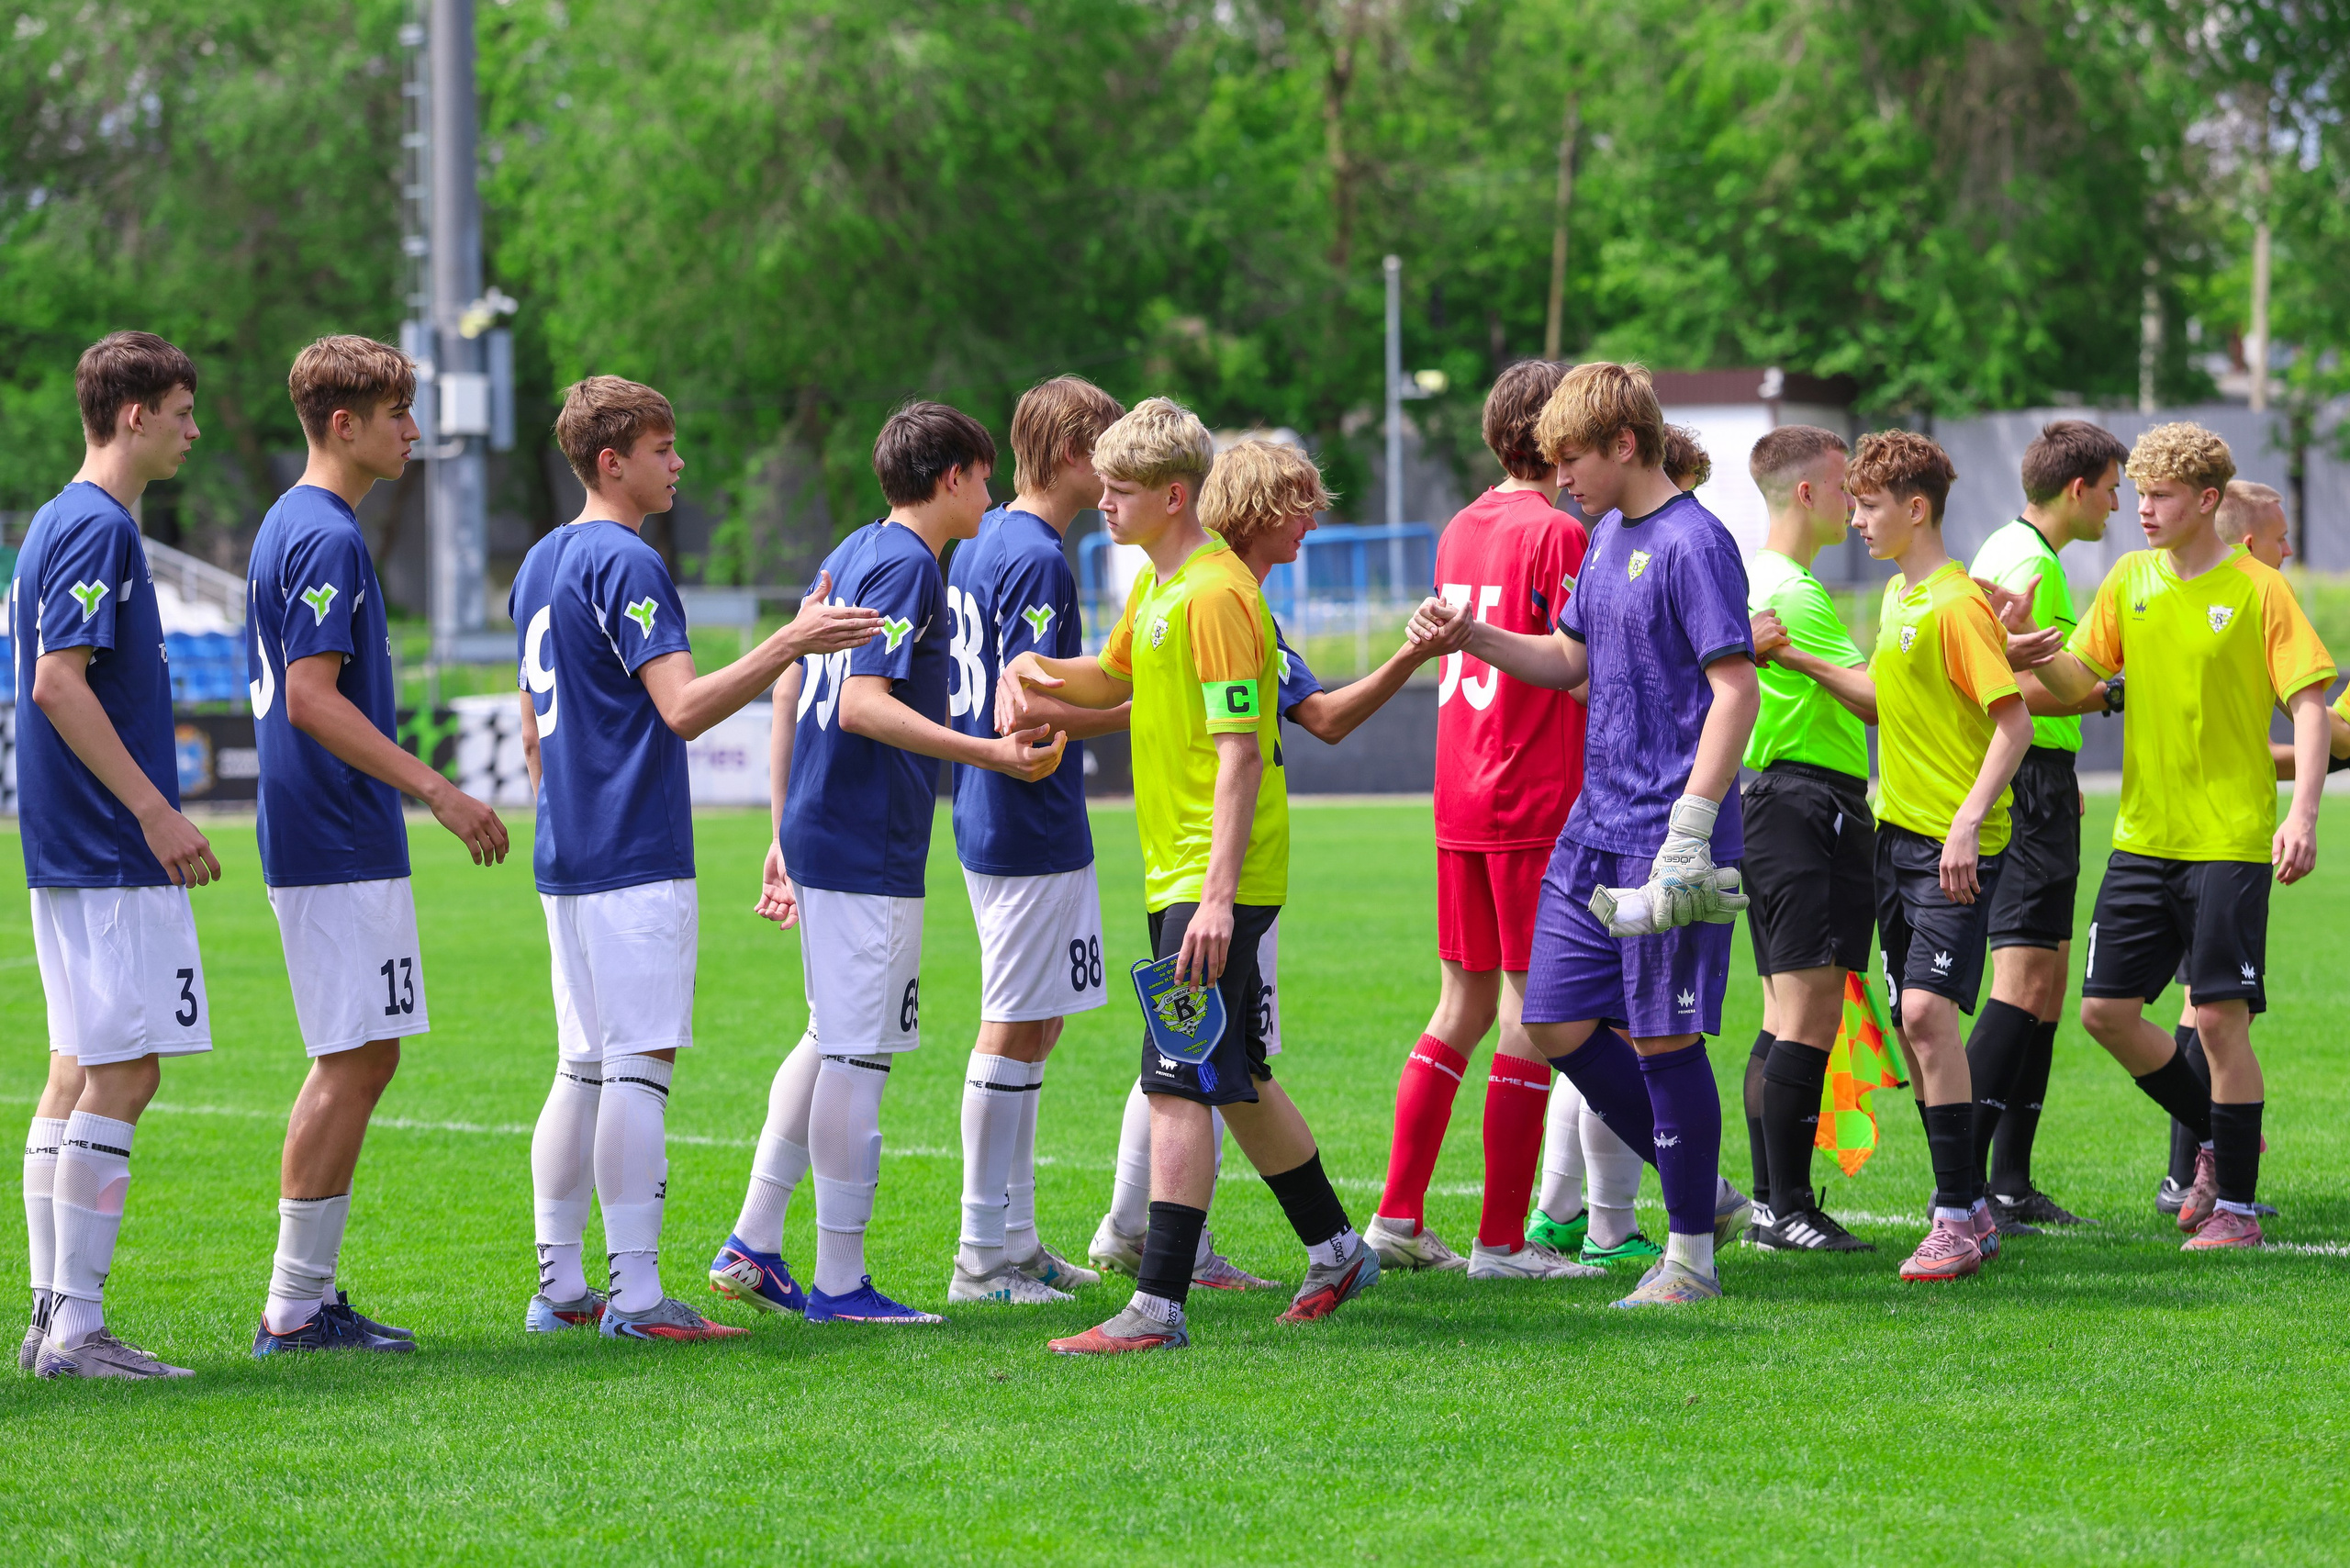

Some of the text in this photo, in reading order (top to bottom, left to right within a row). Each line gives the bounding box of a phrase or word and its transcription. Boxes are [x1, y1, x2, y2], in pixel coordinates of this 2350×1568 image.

[524, 604, 558, 740] 9
[1225, 685, 1250, 713] C
[380, 957, 415, 1016] 13
[1069, 934, 1102, 992] 88
[175, 968, 198, 1027] 3
[1259, 985, 1276, 1036] 6
[1155, 1070, 1176, 1079] PRIMERA
[26, 1147, 59, 1155] ELME
